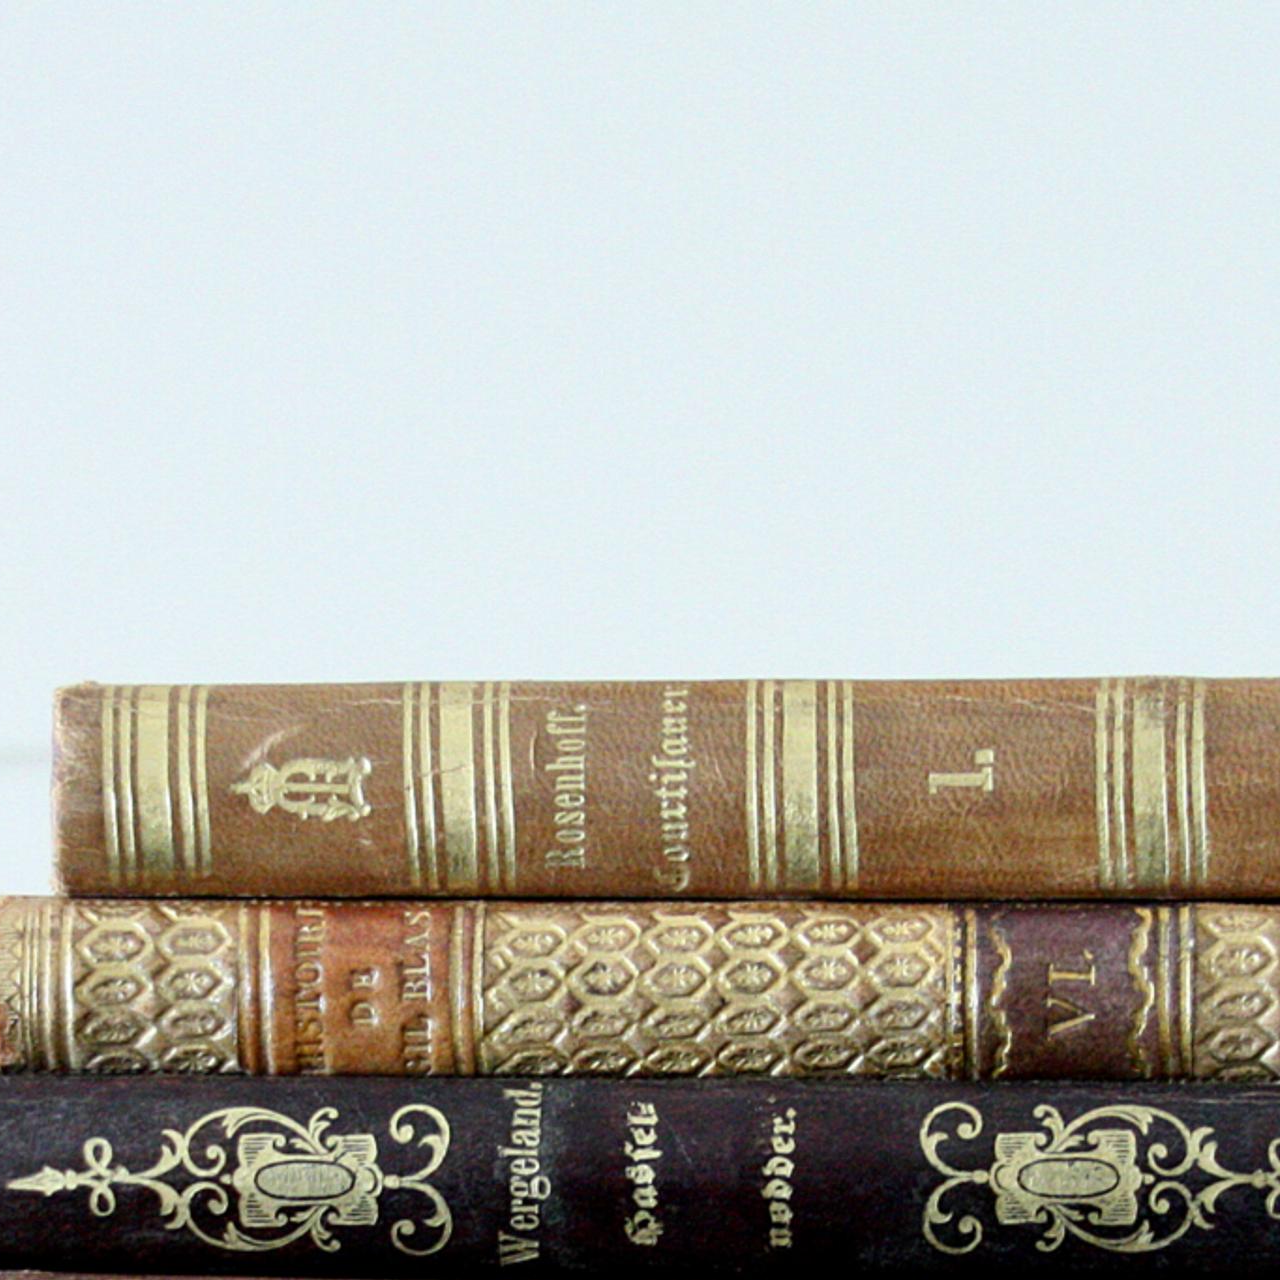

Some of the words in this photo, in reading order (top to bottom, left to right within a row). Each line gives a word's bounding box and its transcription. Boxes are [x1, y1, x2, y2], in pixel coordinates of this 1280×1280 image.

[544, 704, 586, 869] Rosenhoff.
[351, 965, 379, 1026] DE
[402, 910, 432, 1001] BLAS
[498, 1081, 551, 1265] Wergeland.
